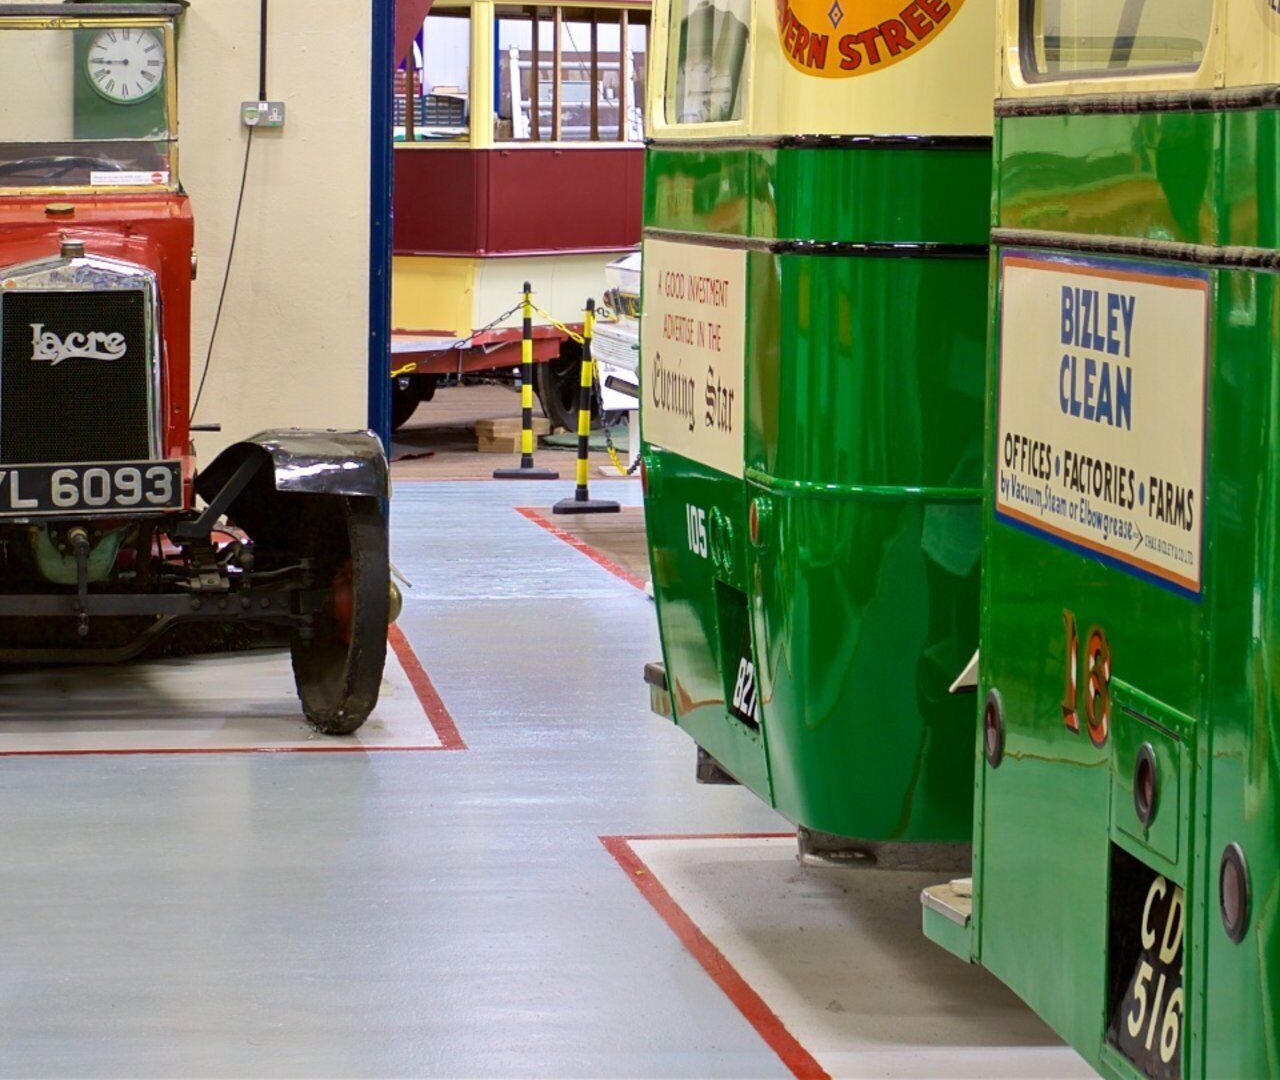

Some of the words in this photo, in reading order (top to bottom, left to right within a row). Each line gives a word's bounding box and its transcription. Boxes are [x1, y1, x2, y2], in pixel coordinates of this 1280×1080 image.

[688, 275, 729, 308] INVESTMENT
[1061, 285, 1135, 358] BIZLEY
[663, 313, 694, 345] ADVERTISE
[708, 322, 721, 352] THE
[652, 351, 696, 433] Evening
[705, 365, 734, 433] Star
[1059, 354, 1132, 431] CLEAN
[50, 468, 174, 508] 6093
[1001, 469, 1009, 502] by
[1069, 501, 1078, 521] or
[1004, 432, 1052, 481] OFFICES
[1064, 450, 1135, 511] FACTORIES
[1148, 476, 1194, 533] FARMS
[686, 503, 707, 559] 105
[1127, 960, 1184, 1064] 516
